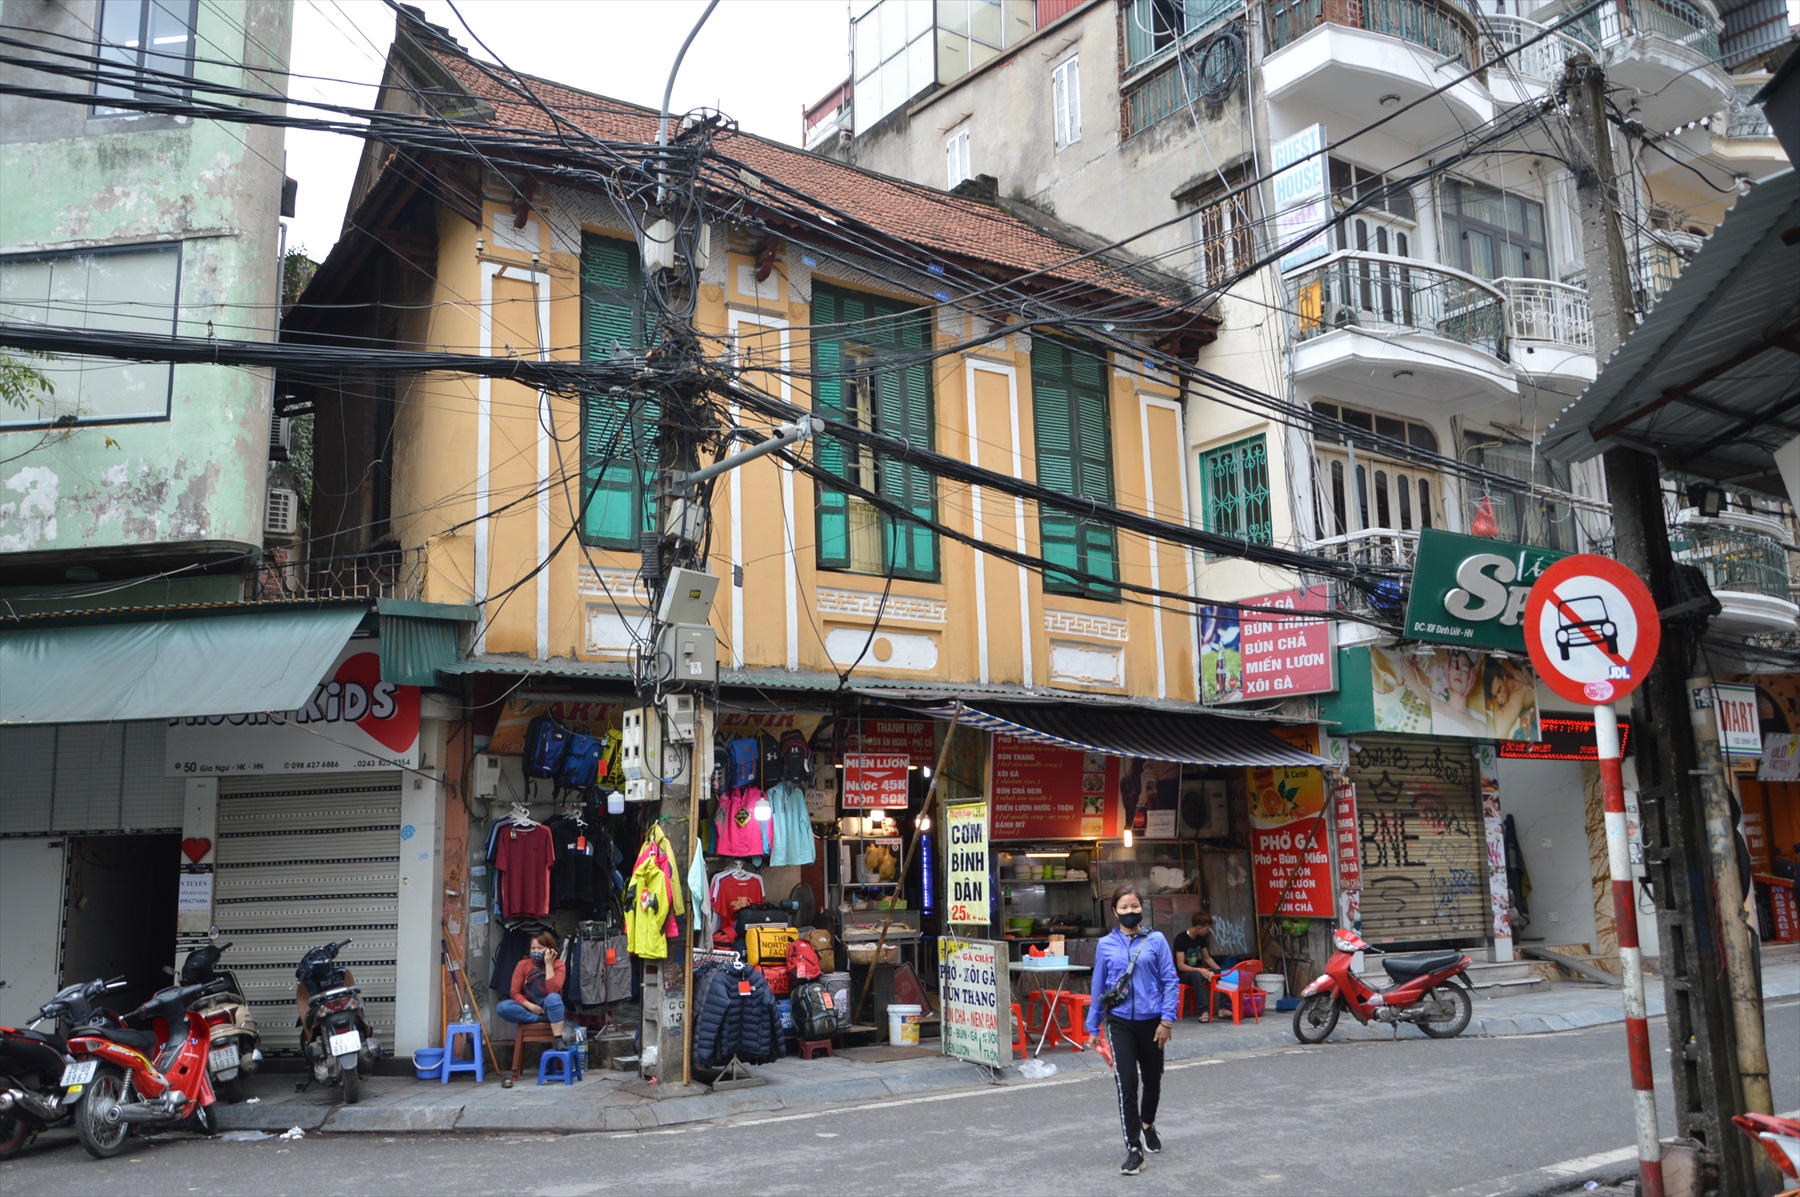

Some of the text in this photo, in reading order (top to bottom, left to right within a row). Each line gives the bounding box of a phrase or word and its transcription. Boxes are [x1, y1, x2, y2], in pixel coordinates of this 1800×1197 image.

[1275, 131, 1317, 171] GUEST
[1277, 162, 1321, 203] HOUSE
[1276, 596, 1294, 610] GÀ
[1244, 621, 1272, 636] BÚN
[1245, 631, 1307, 655] BÚN CHẢ
[1246, 652, 1324, 674] MIẾN LƯƠN
[1246, 674, 1293, 694] XÔI GÀ
[877, 722, 905, 734] THANH
[1771, 745, 1787, 758] OLD
[183, 762, 197, 772] 50
[291, 761, 305, 769] 098
[846, 756, 874, 768] MIẾN
[881, 780, 906, 790] 45K
[880, 794, 906, 804] 50K
[951, 822, 982, 844] CƠM
[1260, 830, 1291, 850] PHỞ
[951, 848, 984, 872] BÌNH
[1279, 853, 1296, 864] Bún
[1305, 852, 1328, 864] Miến
[1272, 866, 1284, 876] GÀ
[954, 877, 982, 902] DÂN
[1295, 888, 1307, 899] GÀ
[1295, 899, 1313, 912] CHẢ
[1772, 886, 1790, 938] MASSAGE
[963, 952, 972, 961] GÀ
[982, 967, 996, 986] GÀ
[962, 989, 995, 1008] THANG
[670, 1012, 683, 1022] 13
[215, 1057, 235, 1069] 1033
